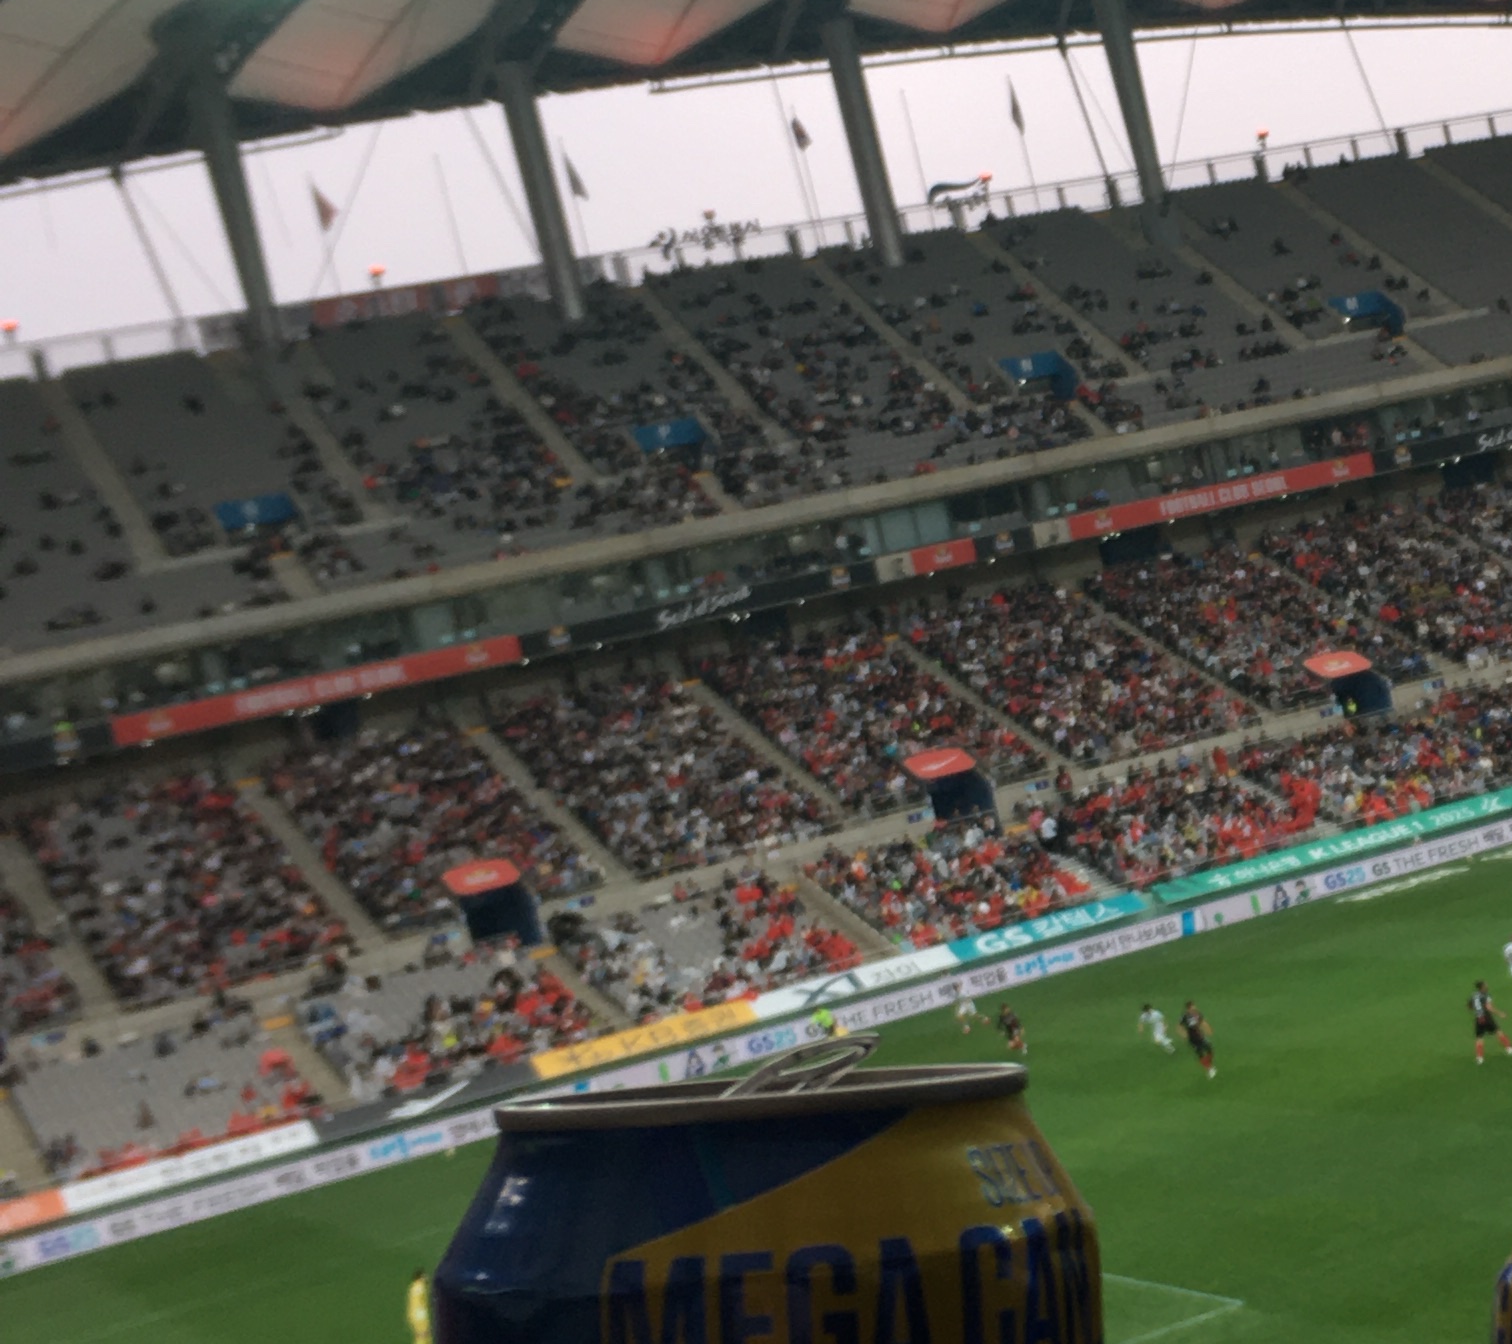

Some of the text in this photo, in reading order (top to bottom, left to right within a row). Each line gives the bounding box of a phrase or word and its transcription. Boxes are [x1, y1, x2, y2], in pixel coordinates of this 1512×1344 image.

[1331, 824, 1412, 855] LEAGUE
[1324, 866, 1366, 890] GS25
[1372, 860, 1391, 877] GS
[1393, 851, 1427, 871] THE
[1428, 836, 1480, 862] FRESH
[976, 926, 1034, 955] GS
[748, 1027, 797, 1054] GS25
[873, 991, 934, 1018] FRESH
